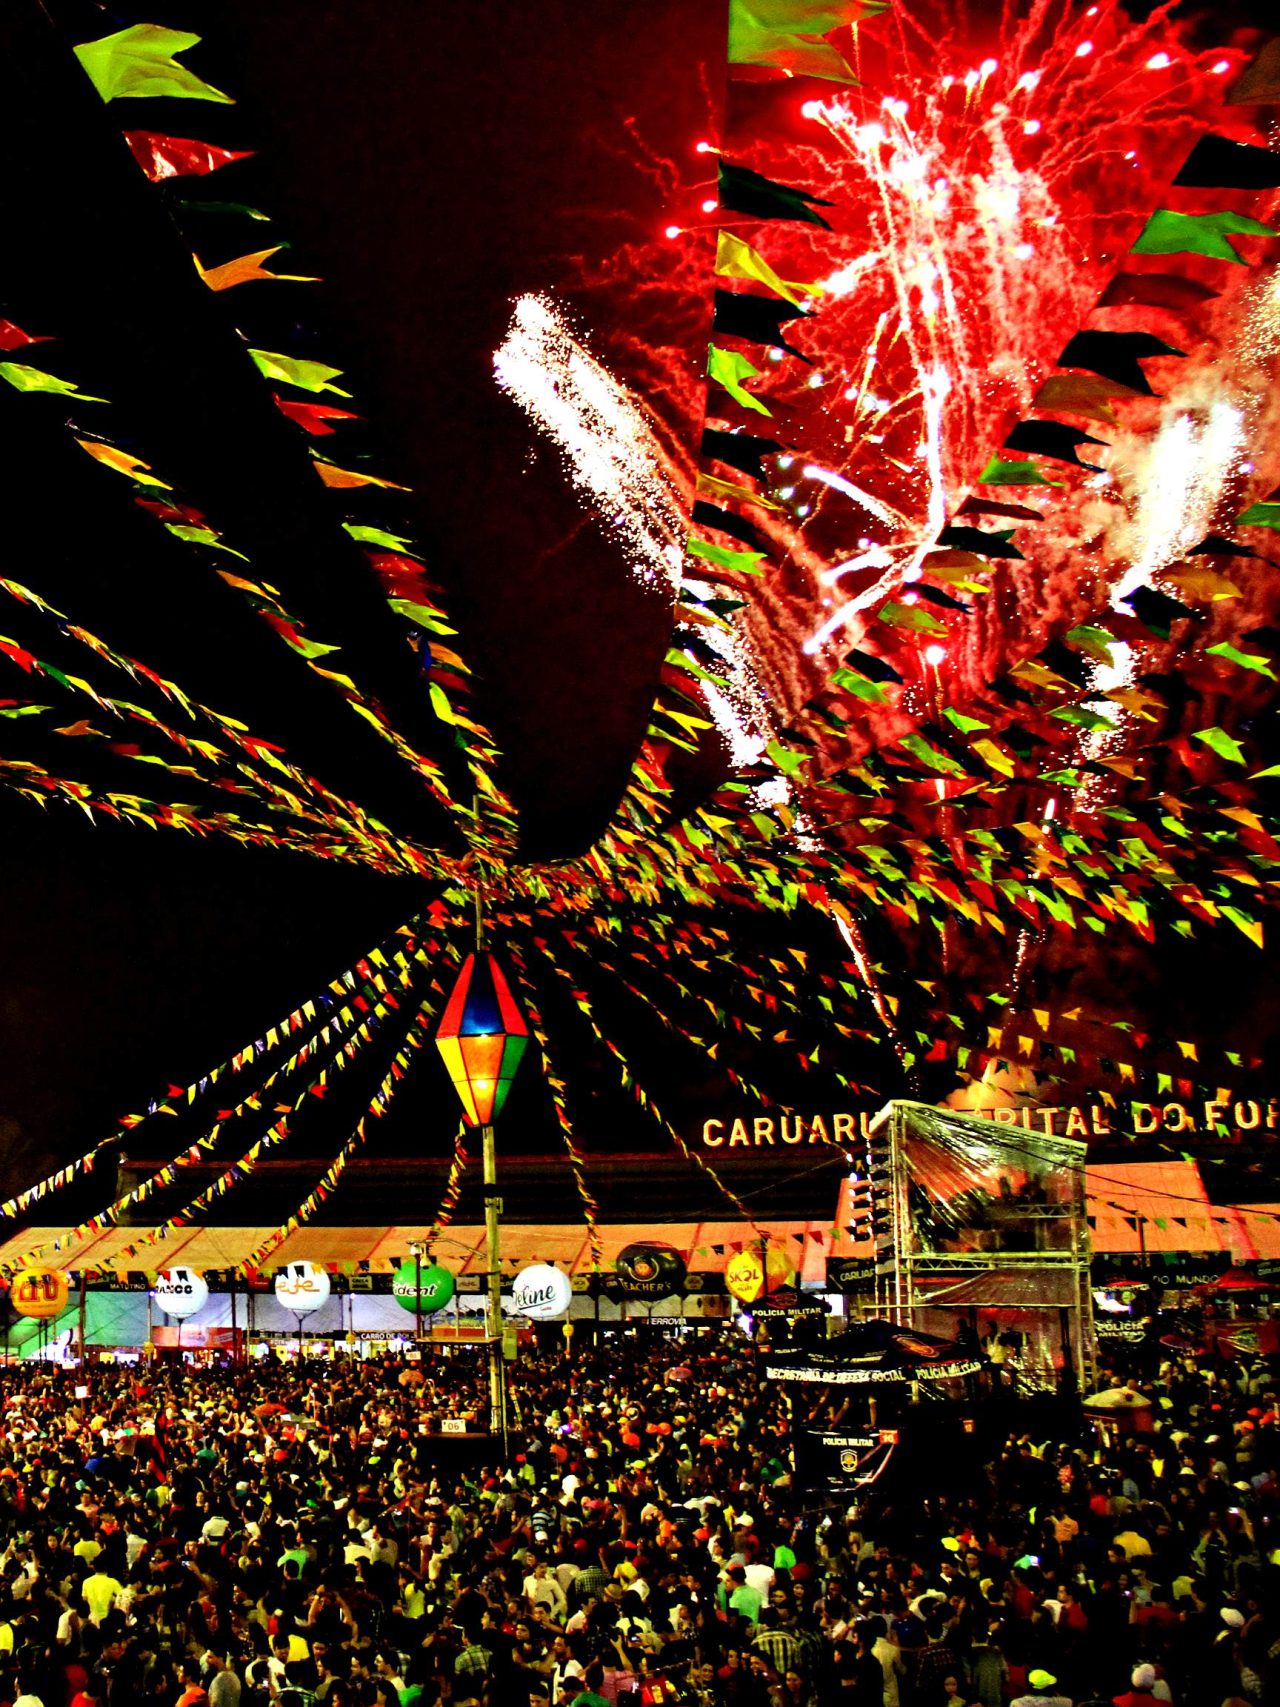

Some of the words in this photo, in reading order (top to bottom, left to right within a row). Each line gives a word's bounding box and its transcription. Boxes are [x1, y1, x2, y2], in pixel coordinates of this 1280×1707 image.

[703, 1112, 871, 1147] CARUARU
[1132, 1103, 1186, 1132] DO
[730, 1269, 760, 1283] SKOL
[1176, 1274, 1219, 1285] MUNDO
[788, 1307, 822, 1315] MILITAR
[871, 1369, 906, 1382] SOCIAL
[448, 1422, 460, 1431] 06
[848, 1438, 874, 1447] MILITAR
